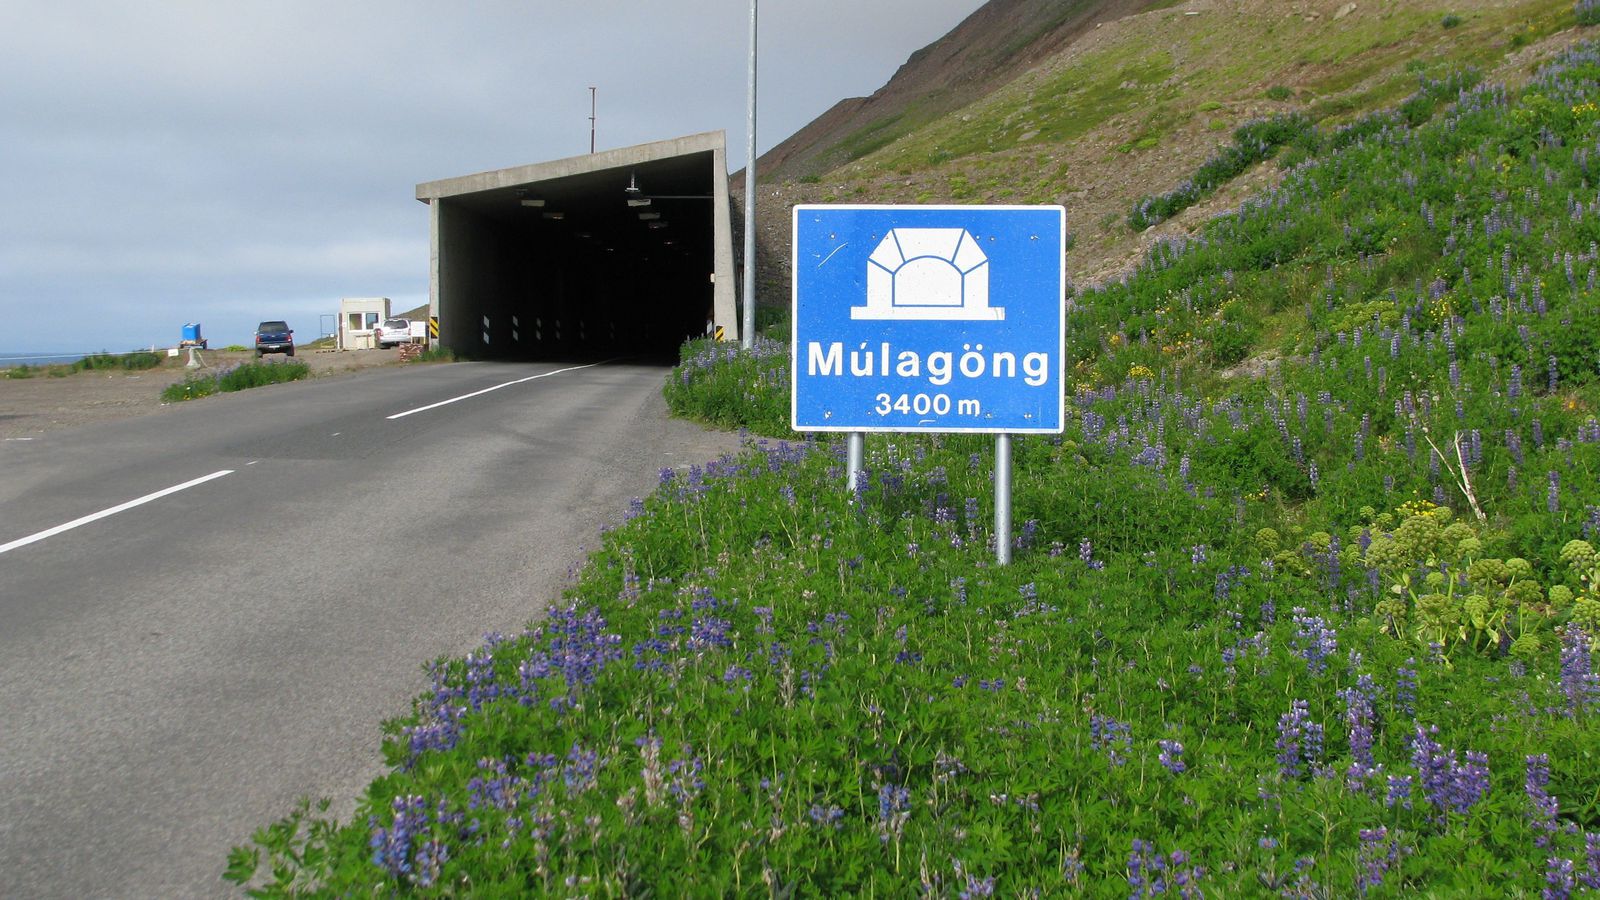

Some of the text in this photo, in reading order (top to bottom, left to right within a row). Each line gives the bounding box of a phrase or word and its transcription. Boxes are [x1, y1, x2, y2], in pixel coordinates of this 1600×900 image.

[808, 341, 1049, 386] Múlagöng
[875, 392, 981, 416] 3400 m
